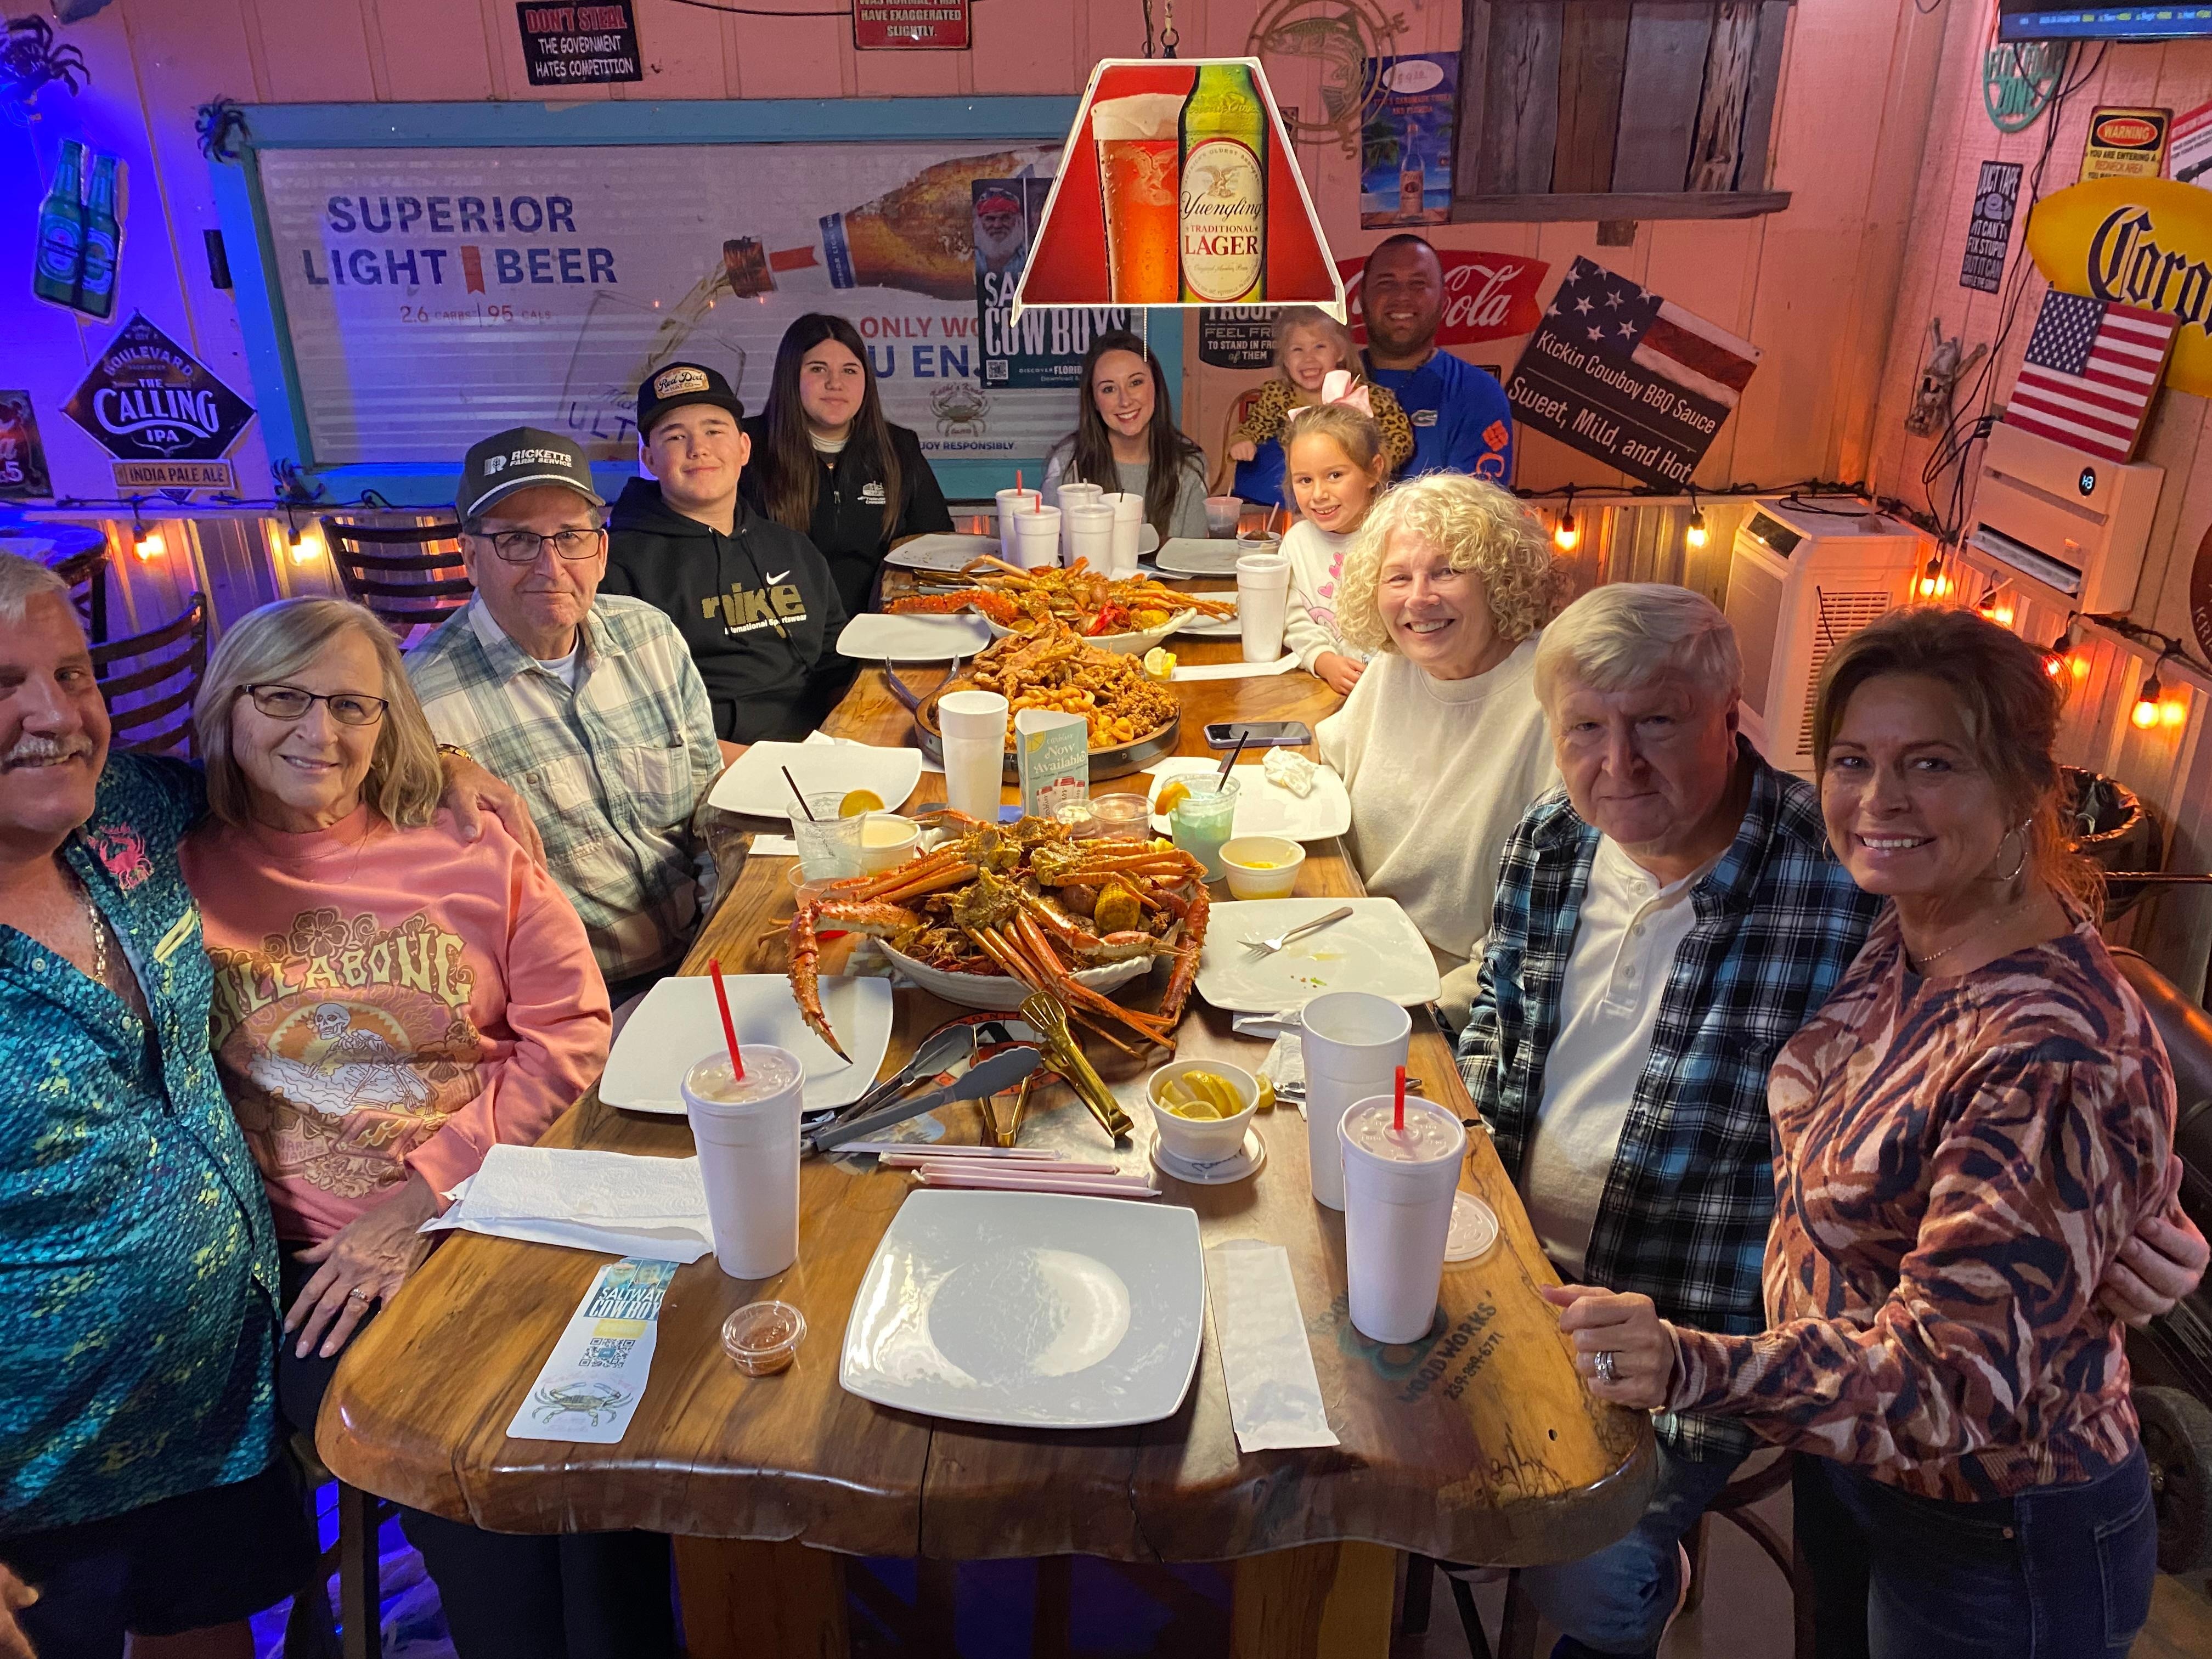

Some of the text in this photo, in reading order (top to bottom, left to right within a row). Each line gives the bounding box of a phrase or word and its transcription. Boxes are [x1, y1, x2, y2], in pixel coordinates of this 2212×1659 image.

[526, 8, 574, 33] DON'T
[861, 9, 961, 20] HAVE EXAGGERATED
[538, 35, 621, 54] THE GOVERNMENT
[535, 58, 634, 77] HATES COMPETITION
[2104, 125, 2150, 140] WARNING
[2090, 150, 2102, 158] YOU
[2103, 150, 2116, 159] ARE
[2117, 151, 2150, 162] ENTERING
[328, 195, 576, 233] SUPERIOR
[1180, 191, 1262, 220] Yuengling
[1190, 225, 1255, 233] TRADITIONAL
[1185, 235, 1259, 256] LAGER
[302, 247, 618, 285] LIGHT BEER
[2087, 206, 2212, 337] Coro
[399, 305, 430, 323] 2.6
[487, 305, 514, 320] 95
[860, 317, 933, 339] ONLY
[1205, 328, 1246, 338] FEEL
[1207, 341, 1219, 350] TO
[1220, 340, 1248, 349] STAND
[1250, 340, 1259, 349] IN
[103, 346, 194, 377] BOULEVARD
[1242, 351, 1267, 360] THEM
[138, 379, 163, 388] THE
[658, 375, 678, 392] Red
[1536, 330, 1717, 435] Kickin Cowboy BBQ Sauce
[93, 388, 220, 438] CALLING
[568, 401, 637, 444] ULT
[1507, 376, 1692, 483] Sweet, Mild, and Hot
[145, 430, 180, 443] IPA
[510, 458, 573, 467] FARM SERVICE
[511, 449, 572, 462] RICKETTS
[129, 467, 224, 483] INDIA PALE ALE
[724, 619, 768, 635] Iternational
[1044, 743, 1075, 760] Now
[1033, 750, 1087, 774] Available
[599, 1287, 665, 1302] SALTWAT
[589, 1299, 660, 1320] COWBOY
